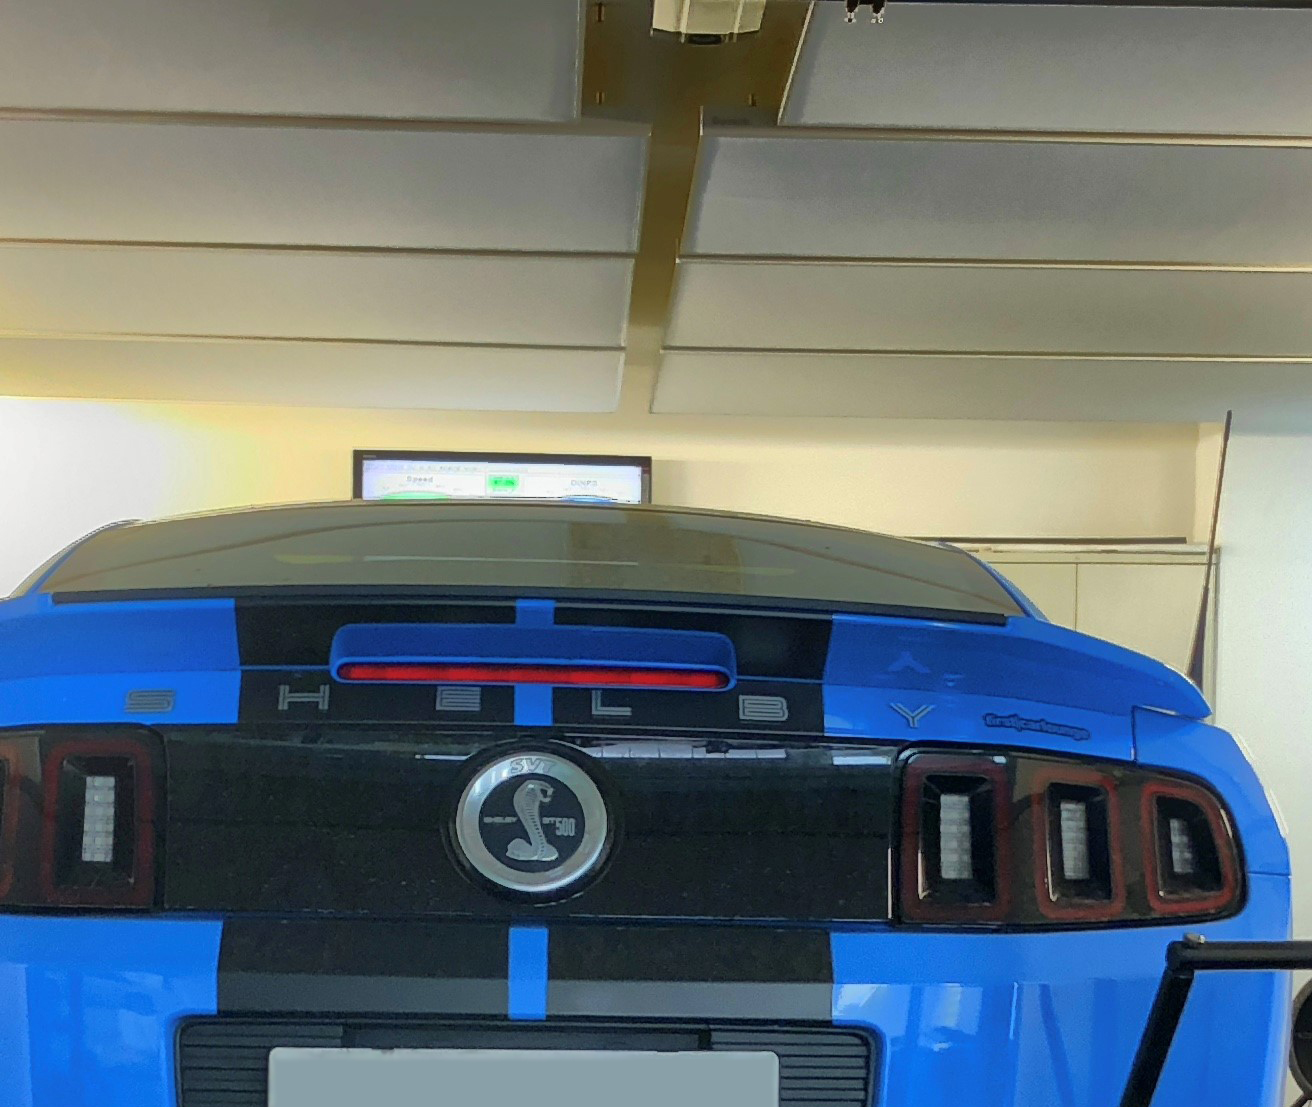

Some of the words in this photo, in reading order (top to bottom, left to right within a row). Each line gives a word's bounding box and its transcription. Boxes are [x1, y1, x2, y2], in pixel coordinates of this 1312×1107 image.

[406, 475, 433, 484] Speed
[510, 757, 555, 774] SVT
[555, 817, 576, 837] 500
